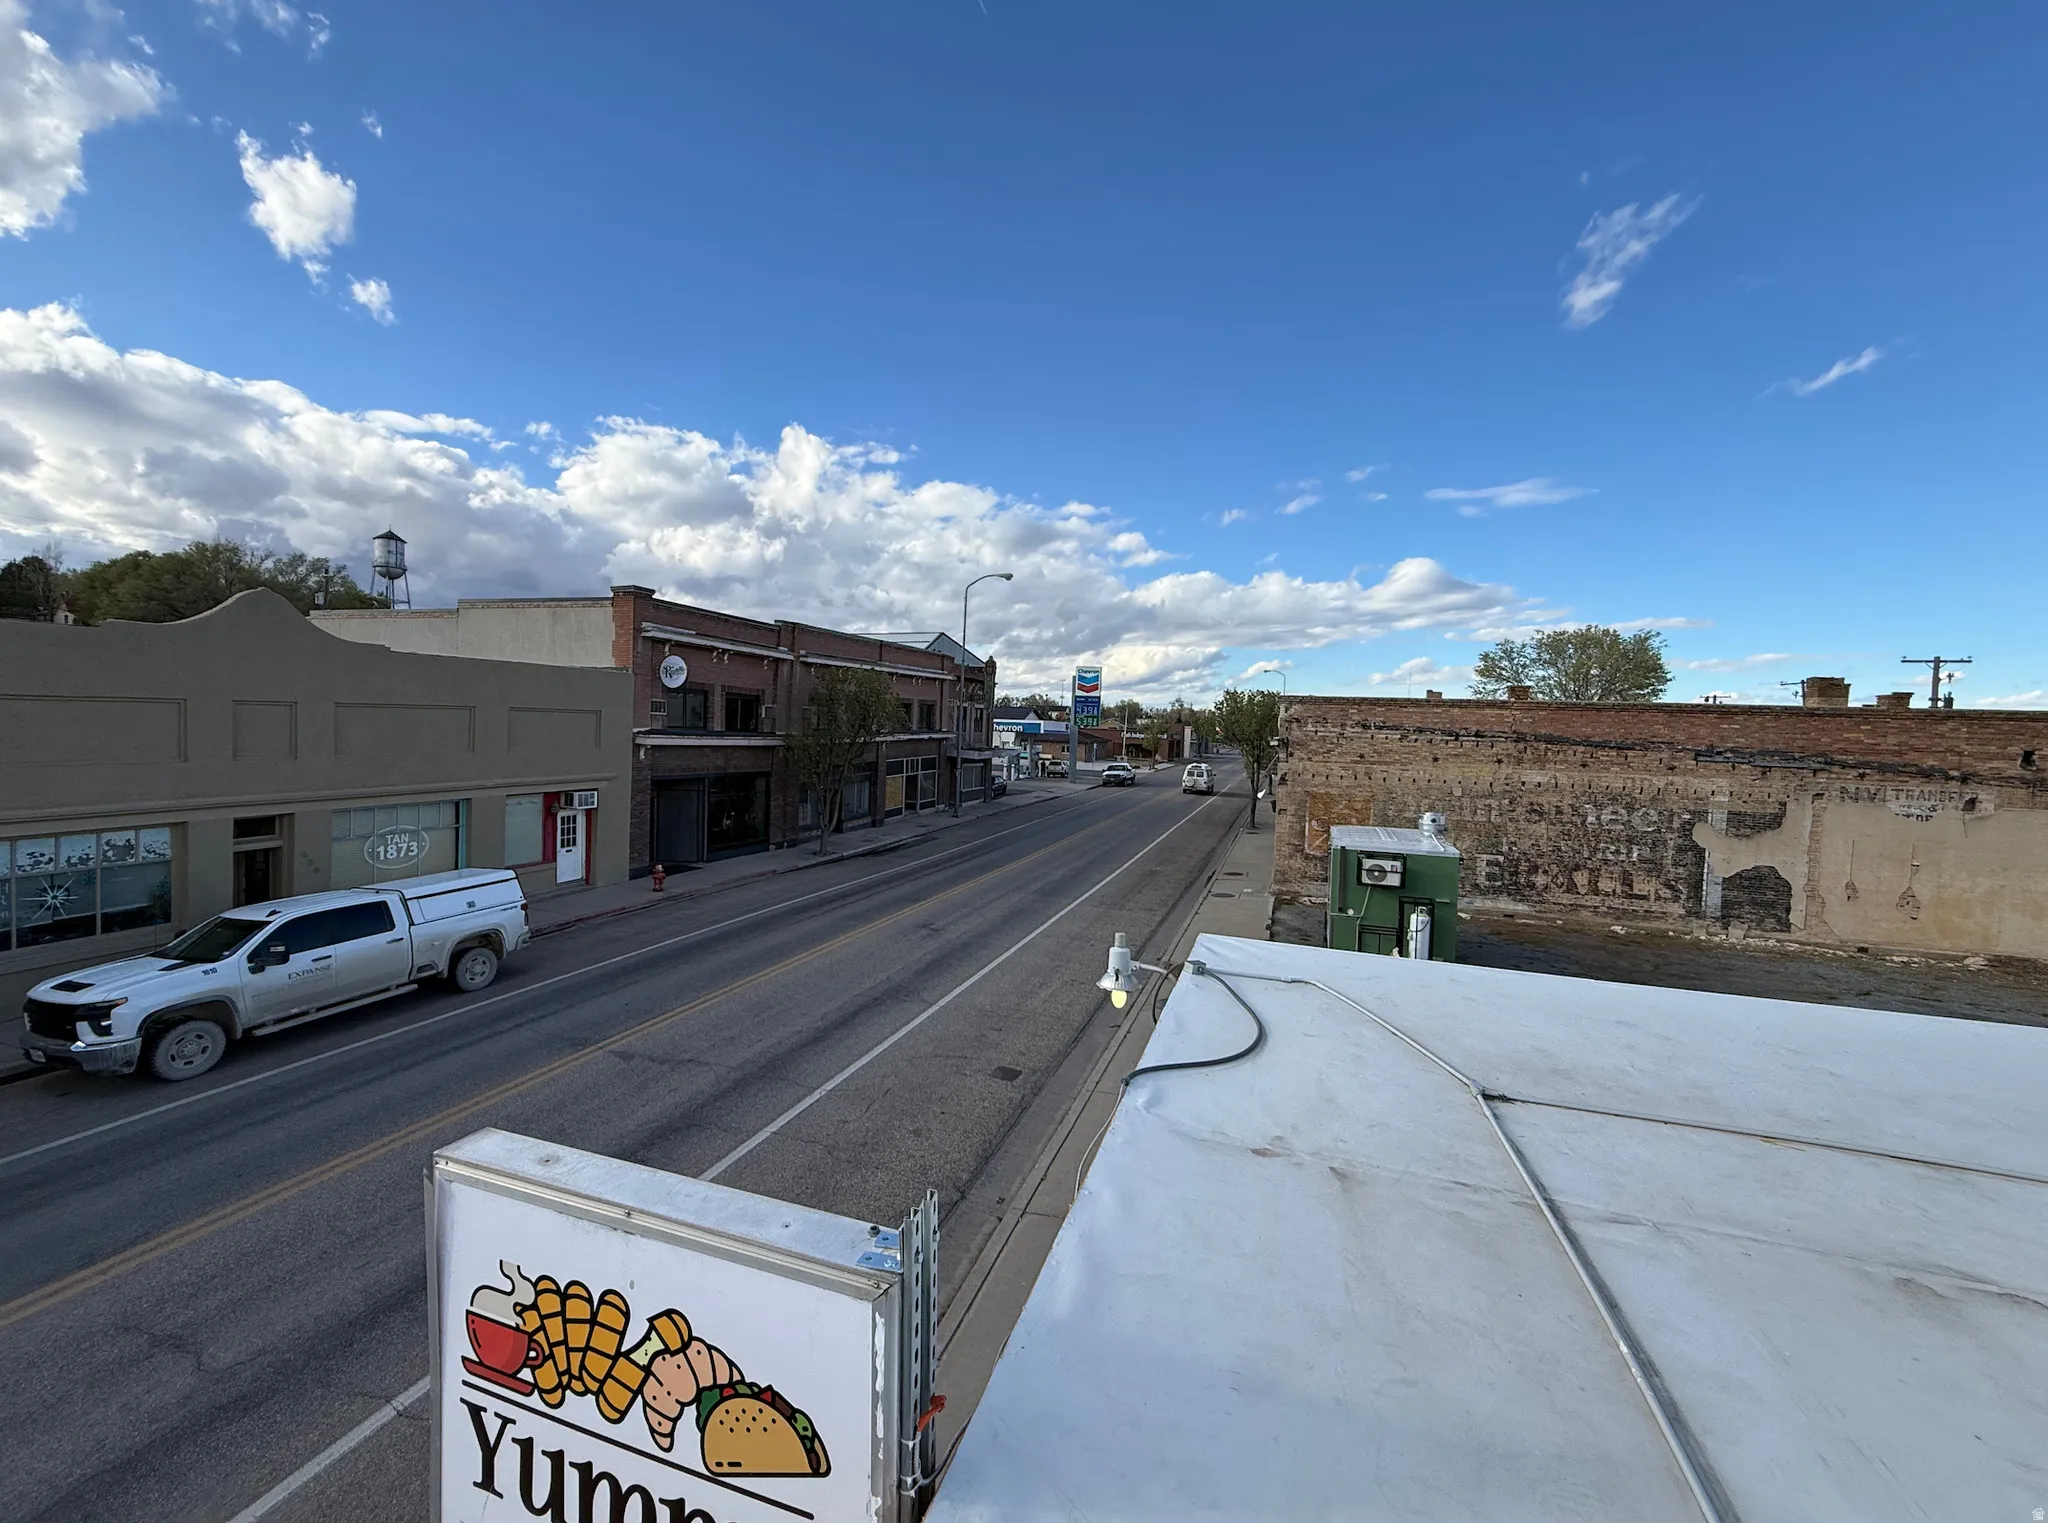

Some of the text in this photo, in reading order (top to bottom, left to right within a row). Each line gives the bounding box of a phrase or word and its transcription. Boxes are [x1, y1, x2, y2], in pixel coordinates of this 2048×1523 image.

[993, 723, 1024, 733] hevron
[385, 832, 410, 845] TAN
[376, 841, 419, 861] 1873
[459, 1397, 738, 1523] Yum
